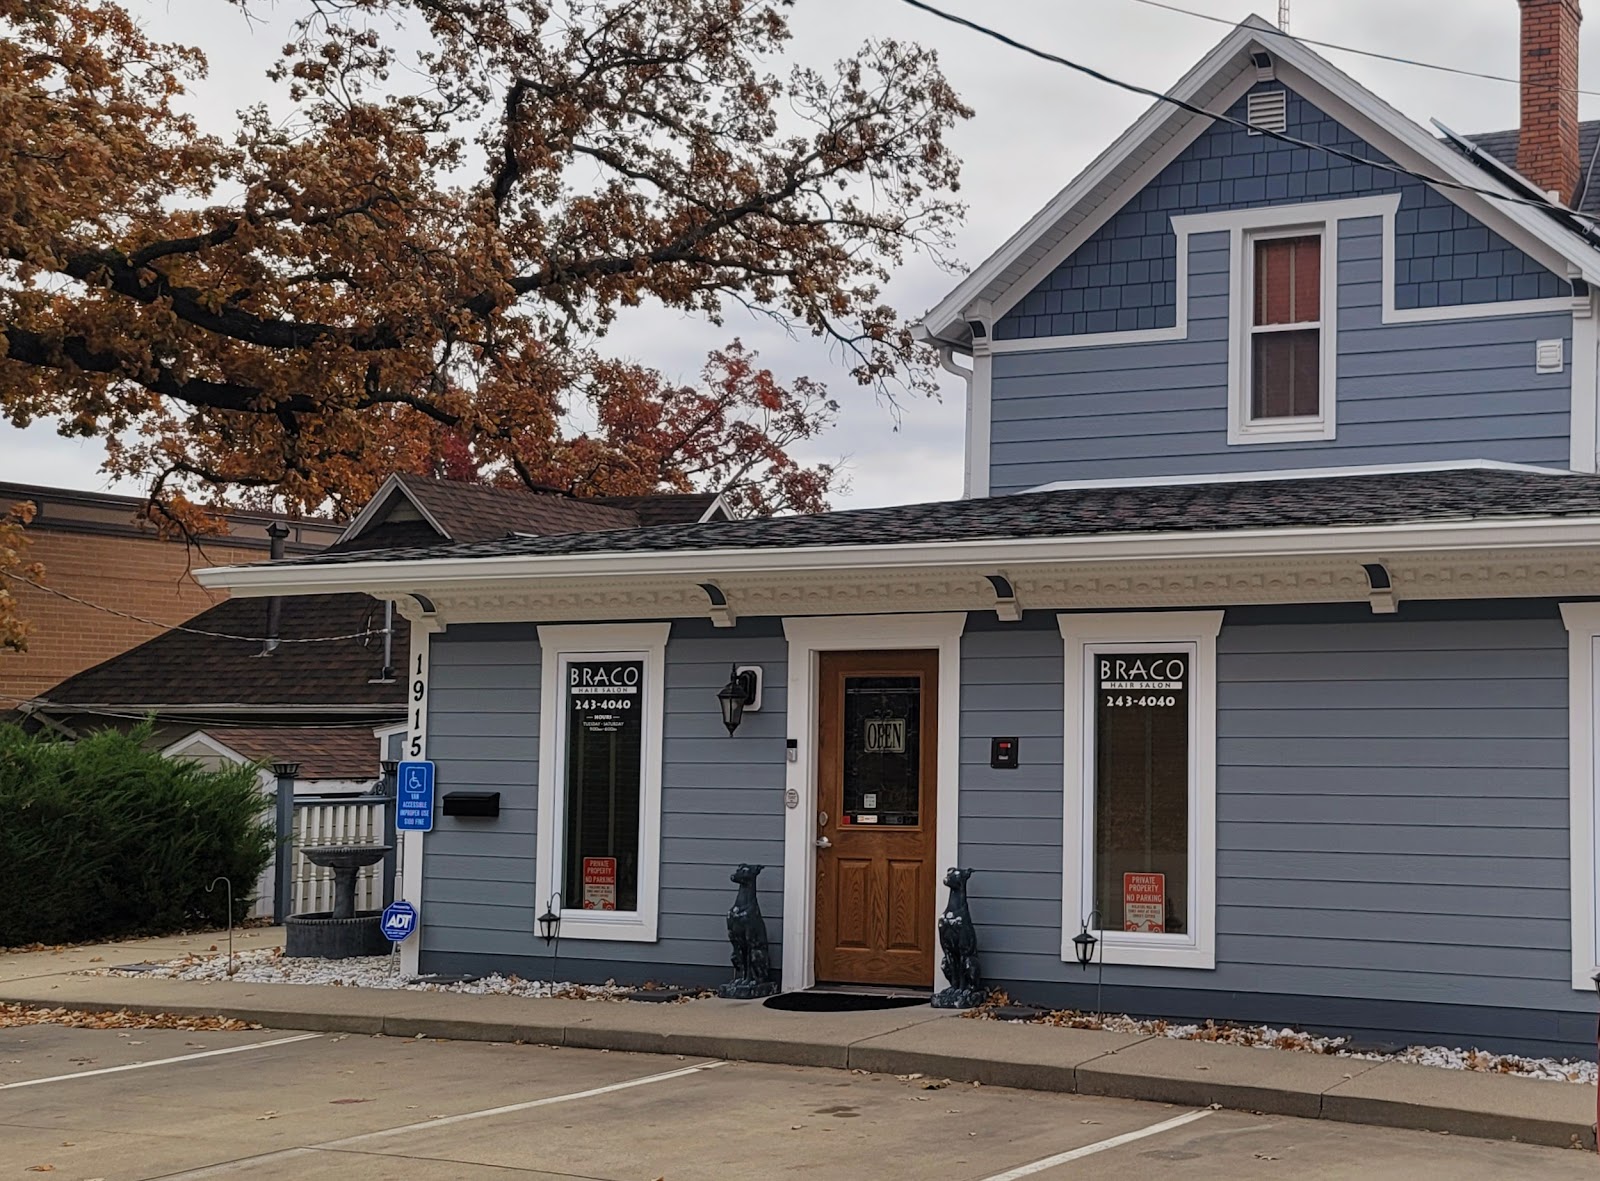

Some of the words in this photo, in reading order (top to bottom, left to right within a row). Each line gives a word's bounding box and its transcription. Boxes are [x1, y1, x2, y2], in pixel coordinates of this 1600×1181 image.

[1101, 659, 1184, 680] BRACO
[571, 666, 639, 686] BRACO
[410, 653, 424, 757] 1915
[575, 699, 631, 710] 243-4040
[1106, 695, 1176, 707] 243-4040
[867, 723, 902, 749] OPEN
[586, 867, 612, 875] PROPERTY
[593, 876, 615, 884] PARKING
[1131, 876, 1156, 884] PRIVATE
[1128, 884, 1159, 892] PROPERTY
[1126, 894, 1135, 902] NO
[1136, 894, 1162, 903] PARKING
[386, 914, 412, 929] ADT
